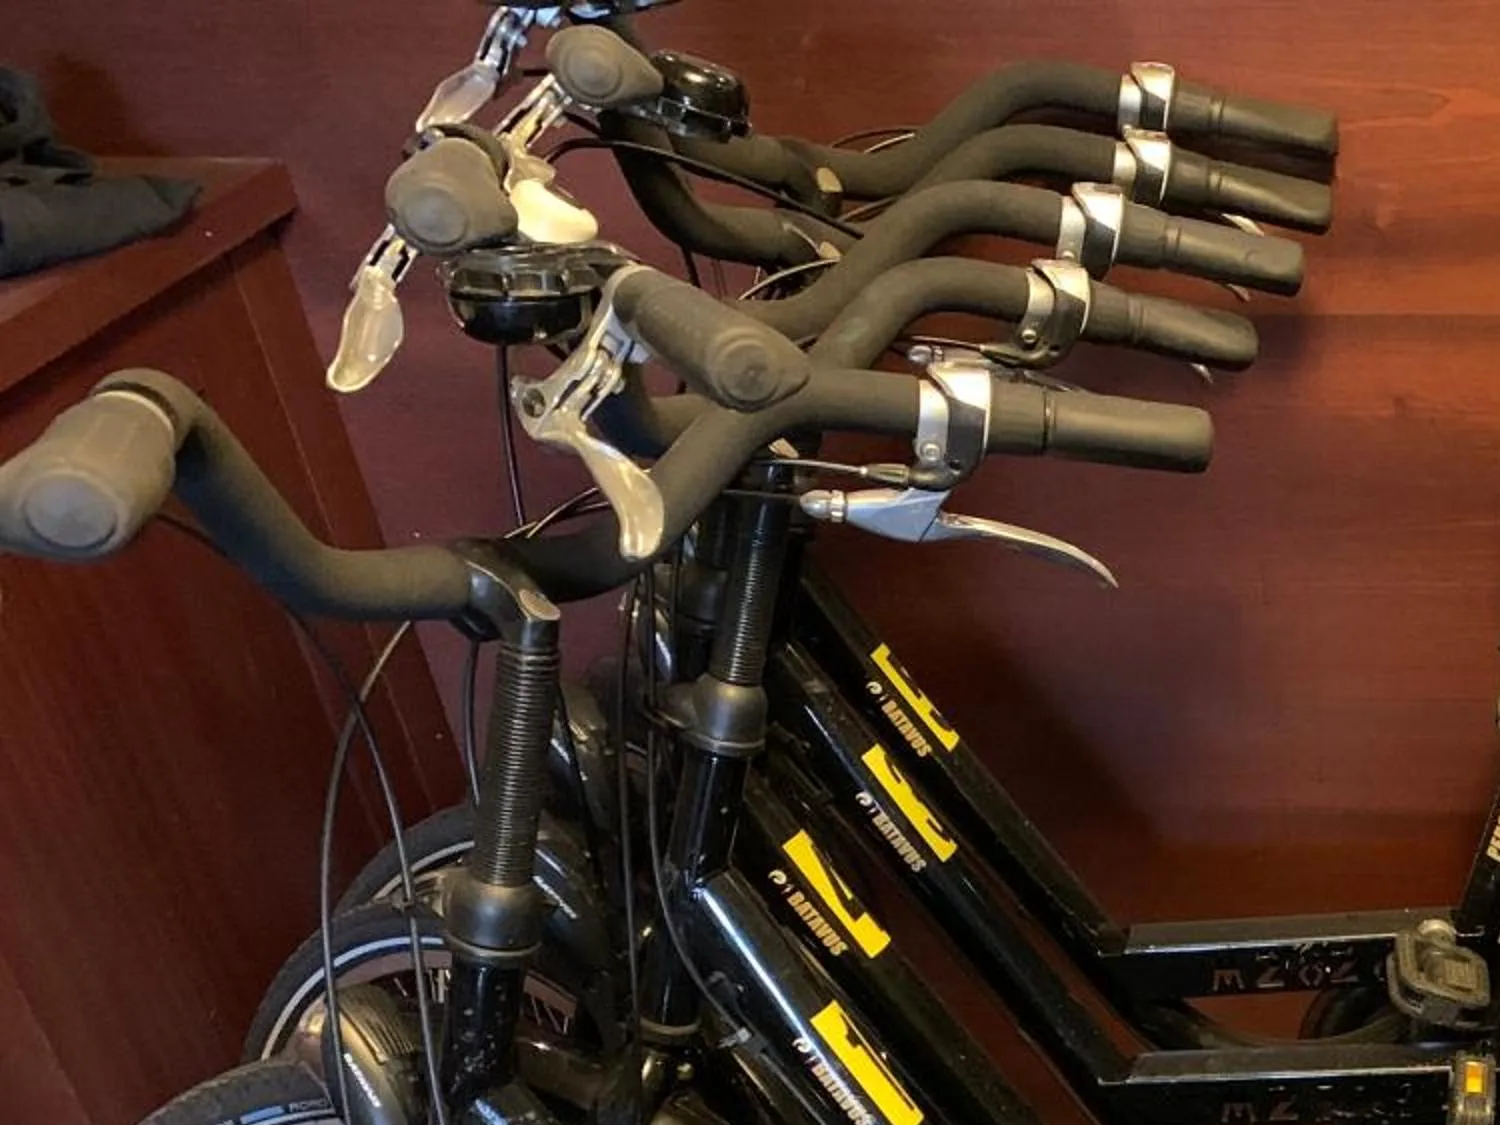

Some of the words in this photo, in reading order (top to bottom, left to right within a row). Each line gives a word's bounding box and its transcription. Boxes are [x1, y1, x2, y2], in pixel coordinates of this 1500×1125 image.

[881, 699, 932, 758] BATAVUS
[872, 806, 927, 873] BATAVUS
[786, 893, 849, 957] BATAVUS
